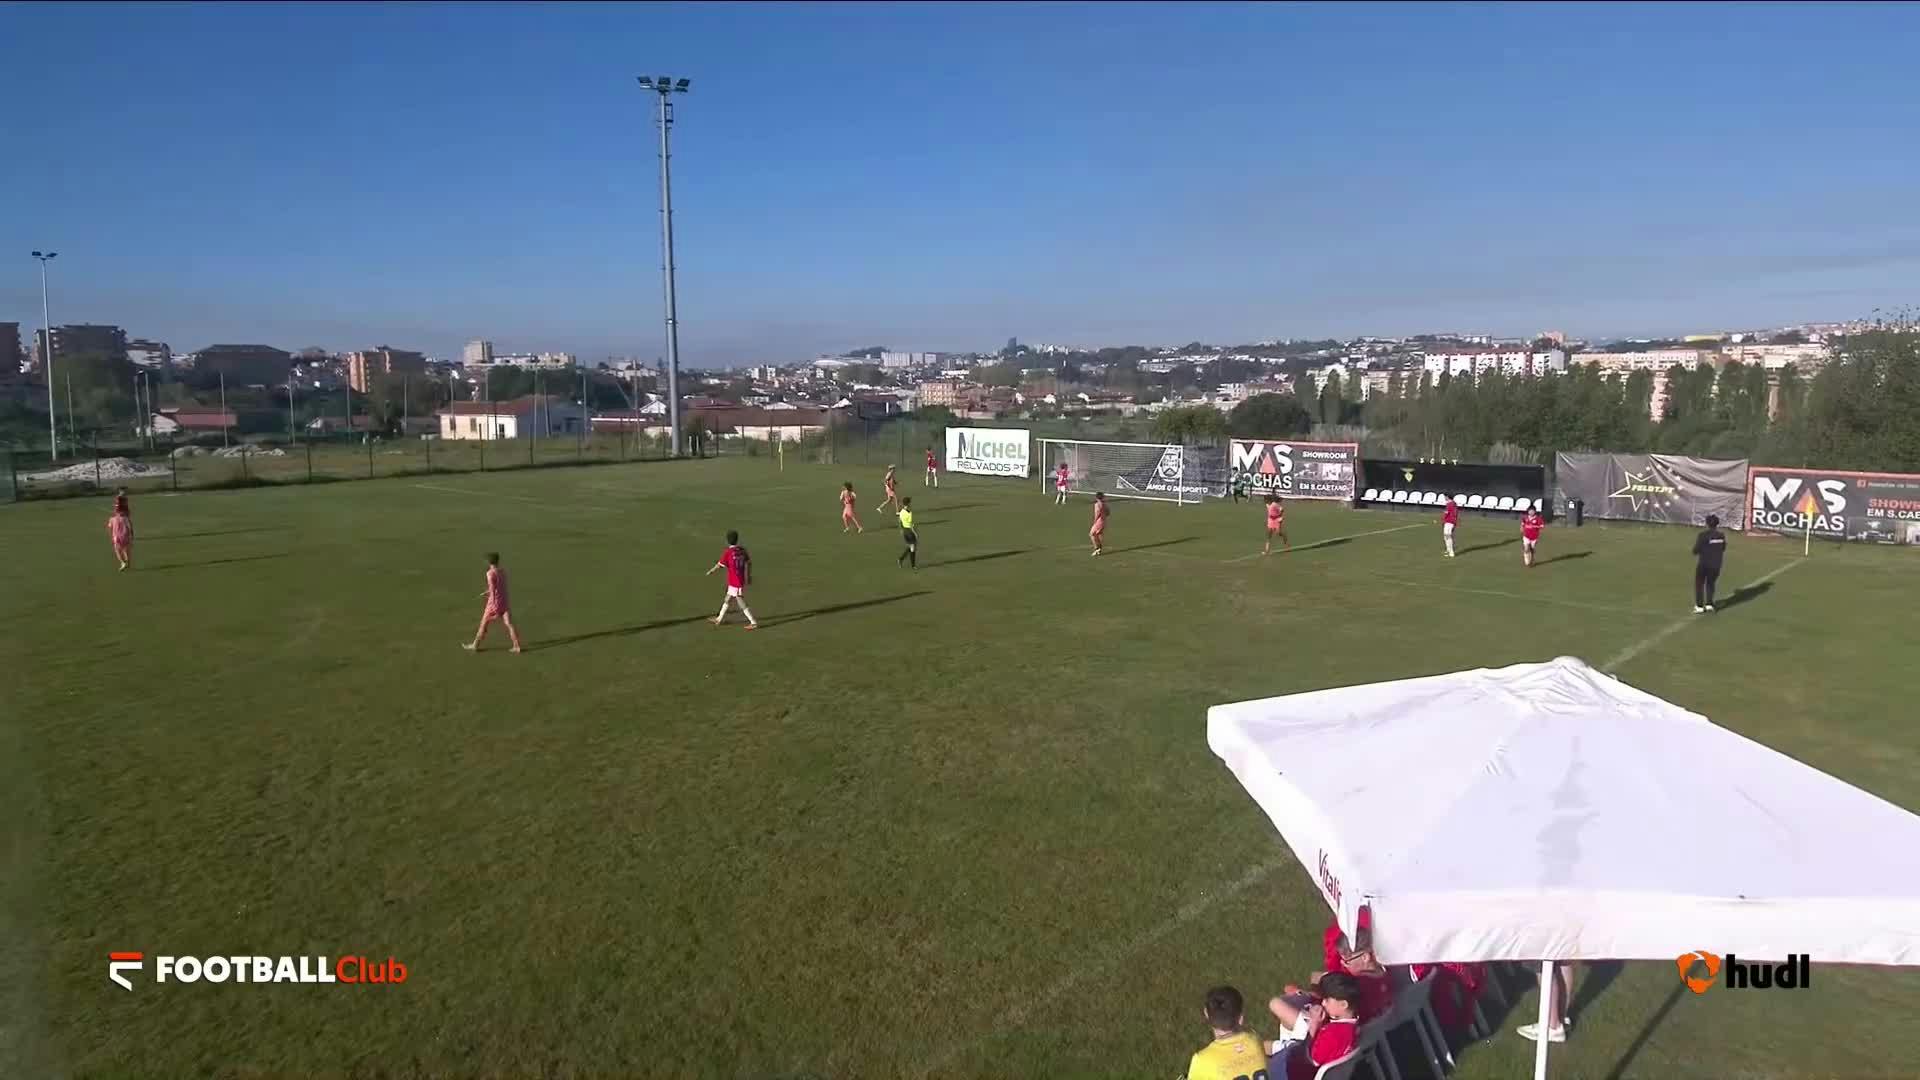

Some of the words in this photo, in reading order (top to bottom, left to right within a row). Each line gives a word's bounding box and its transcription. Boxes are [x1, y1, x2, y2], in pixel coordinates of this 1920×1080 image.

[1302, 450, 1347, 459] SHOWROOM
[957, 460, 1026, 473] RELVADOS.PT
[1173, 486, 1208, 494] DSPORTO
[1867, 508, 1884, 517] EM
[1752, 509, 1845, 531] ROCHAS
